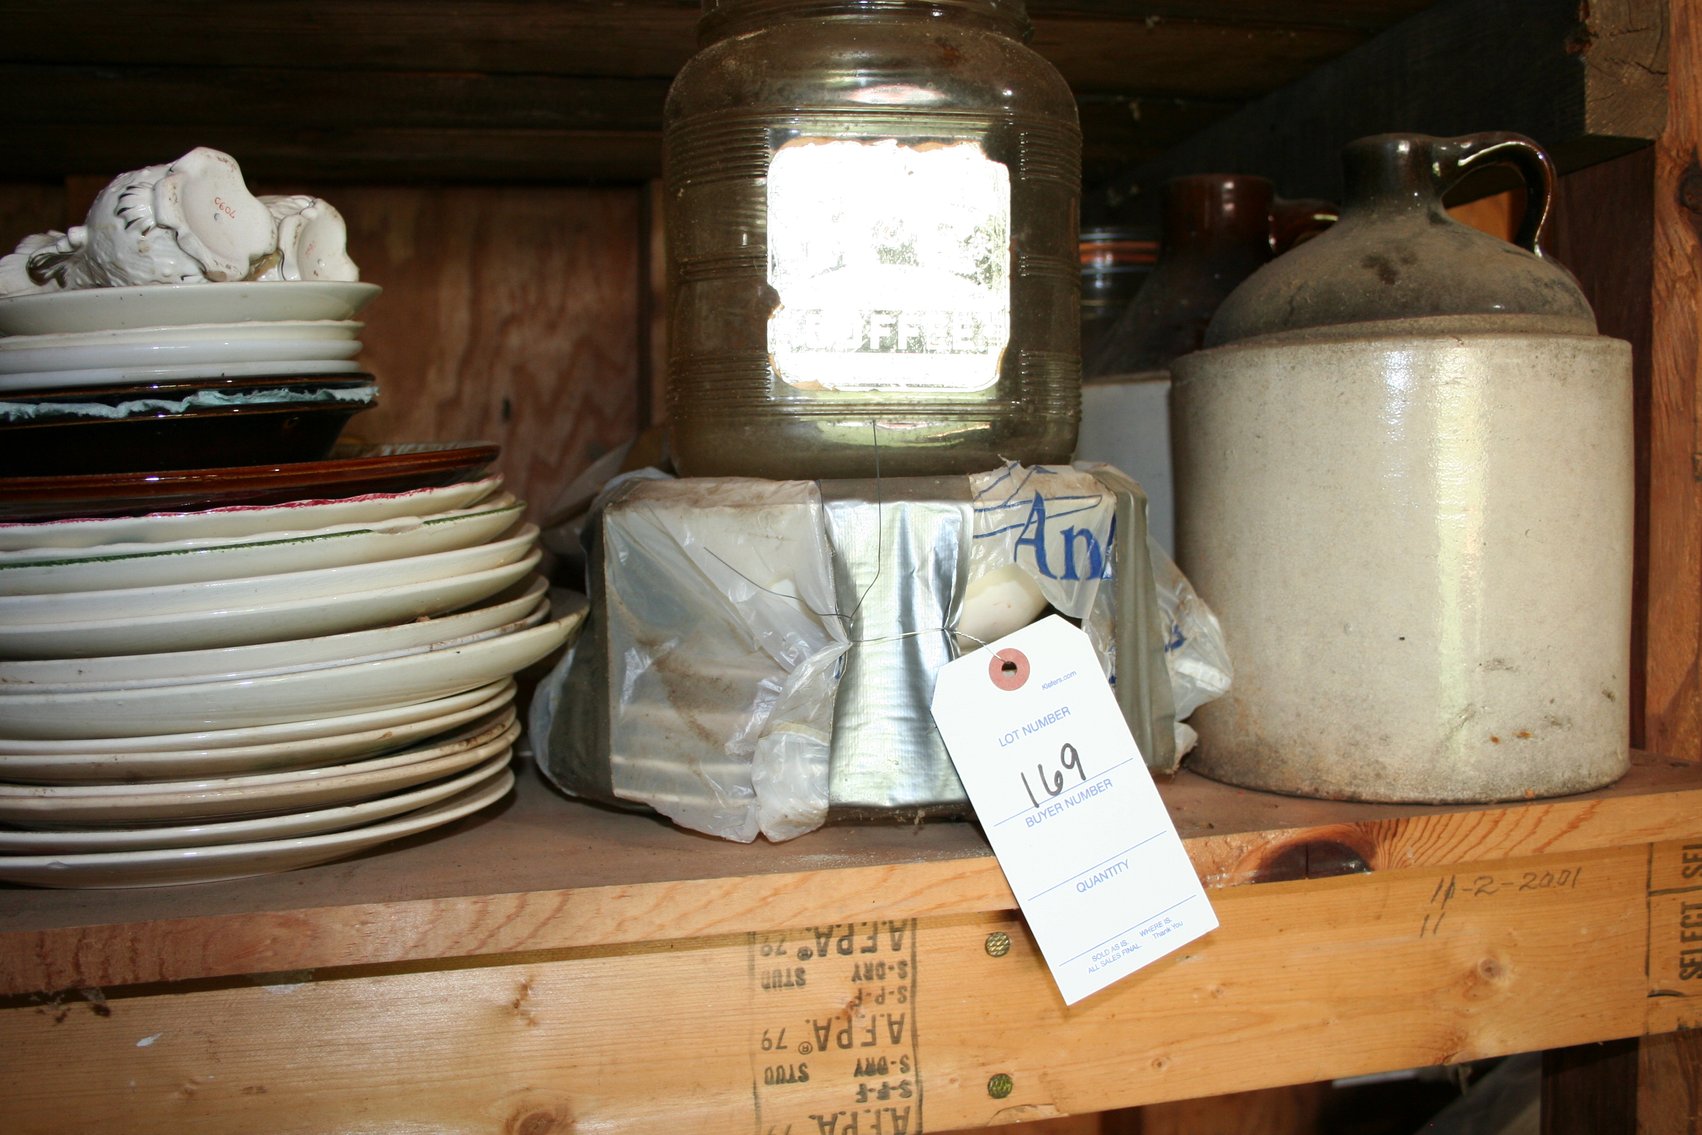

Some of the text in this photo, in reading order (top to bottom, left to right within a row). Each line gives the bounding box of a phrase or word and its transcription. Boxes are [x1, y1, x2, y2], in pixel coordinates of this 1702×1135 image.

[999, 706, 1072, 747] LOT NUMBER
[1021, 743, 1086, 808] 169
[1025, 778, 1113, 828] BUYER NUMBER
[1076, 859, 1130, 893] QUANTITY
[1139, 920, 1163, 938] WHERE
[1151, 920, 1184, 940] Thank You
[1088, 964, 1100, 975] ALL
[1100, 953, 1121, 968] SALES
[1091, 948, 1110, 963] SOLD
[1111, 943, 1120, 953] AS
[761, 1027, 788, 1051] 79
[764, 1062, 810, 1085] STUD
